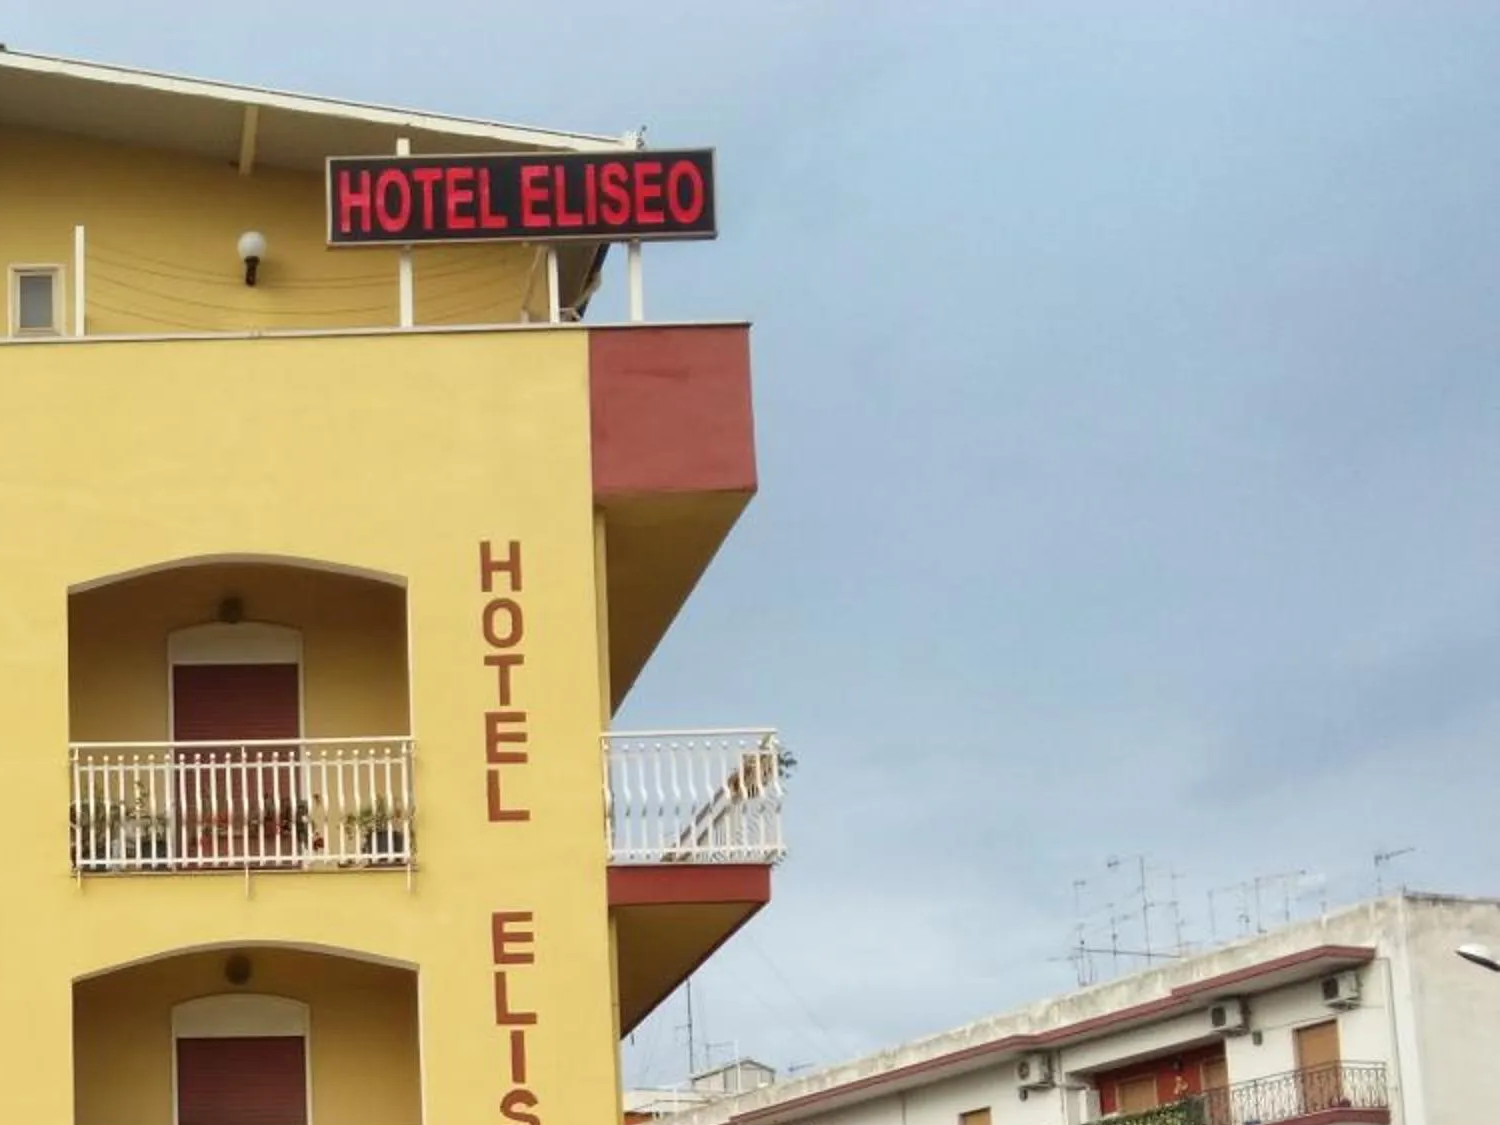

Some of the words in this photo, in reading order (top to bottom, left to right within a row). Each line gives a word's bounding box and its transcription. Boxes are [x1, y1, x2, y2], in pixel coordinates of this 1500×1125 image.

[339, 167, 508, 233] HOTEL
[520, 159, 704, 228] ELISEO
[479, 540, 531, 823] HOTEL
